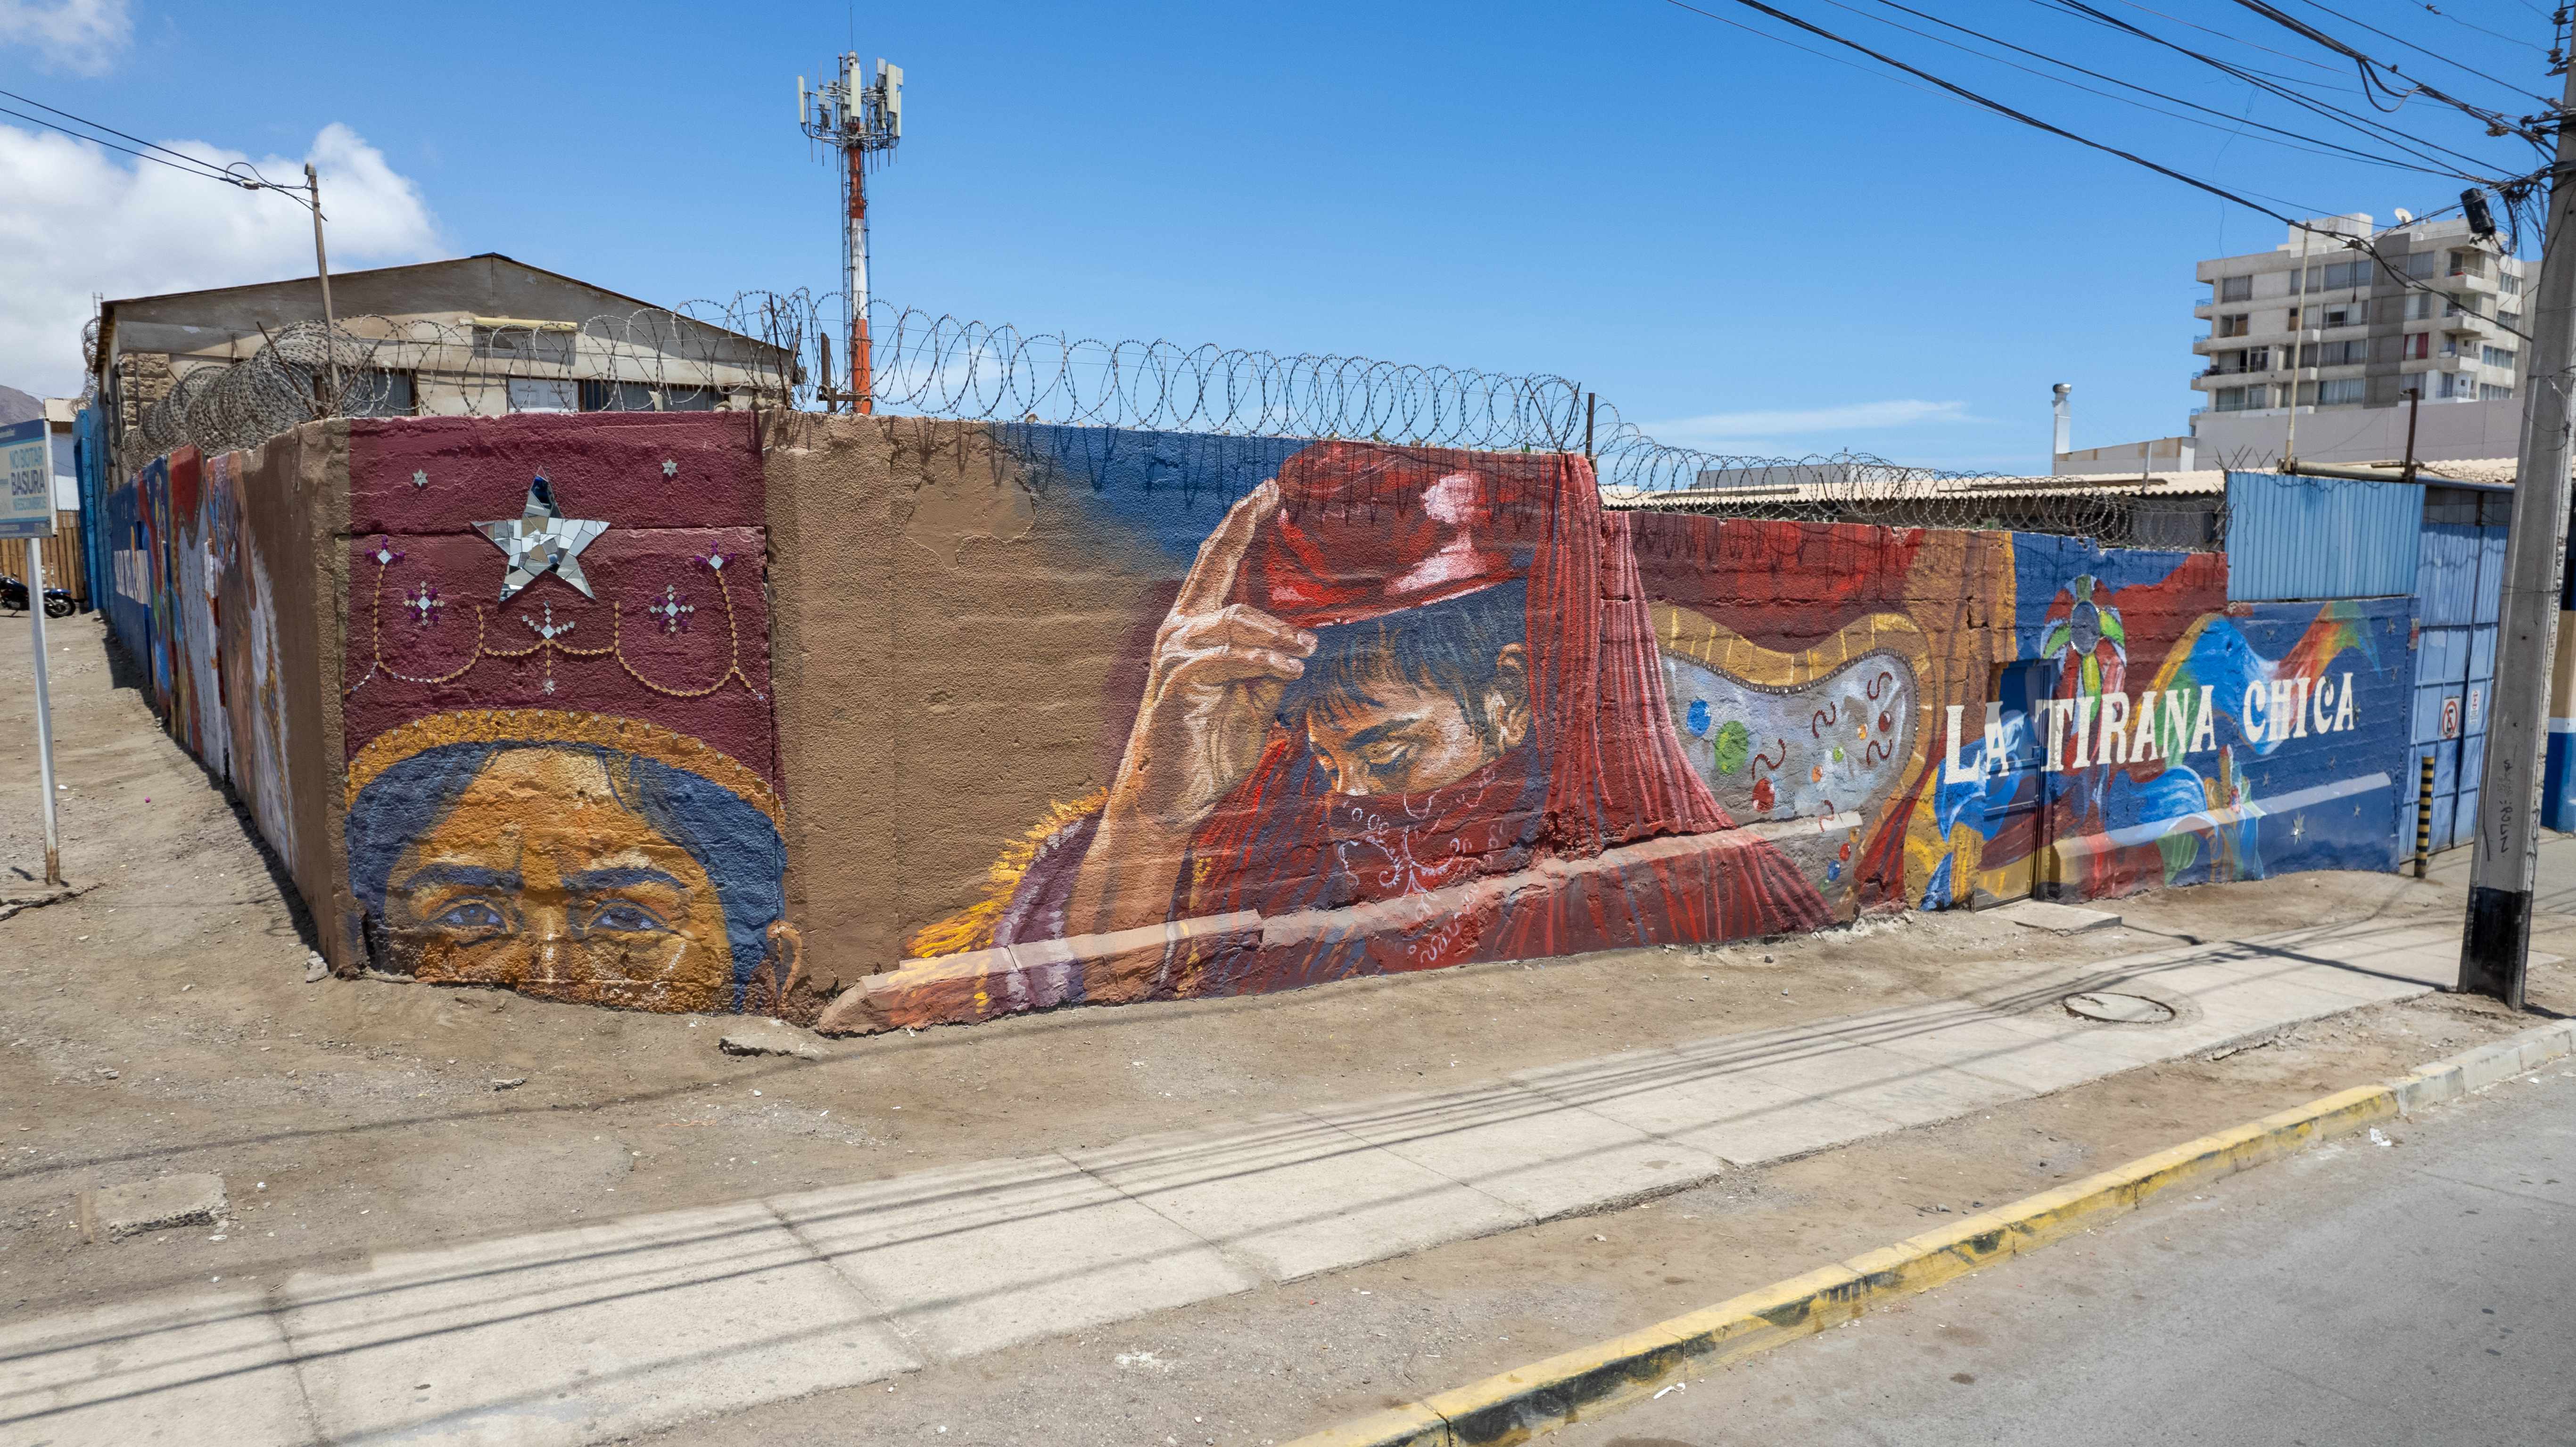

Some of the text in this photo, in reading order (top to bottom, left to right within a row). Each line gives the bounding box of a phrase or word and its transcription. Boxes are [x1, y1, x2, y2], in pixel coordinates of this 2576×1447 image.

[11, 469, 46, 495] BASURA
[1943, 672, 2355, 785] LA TIRANA CHICA
